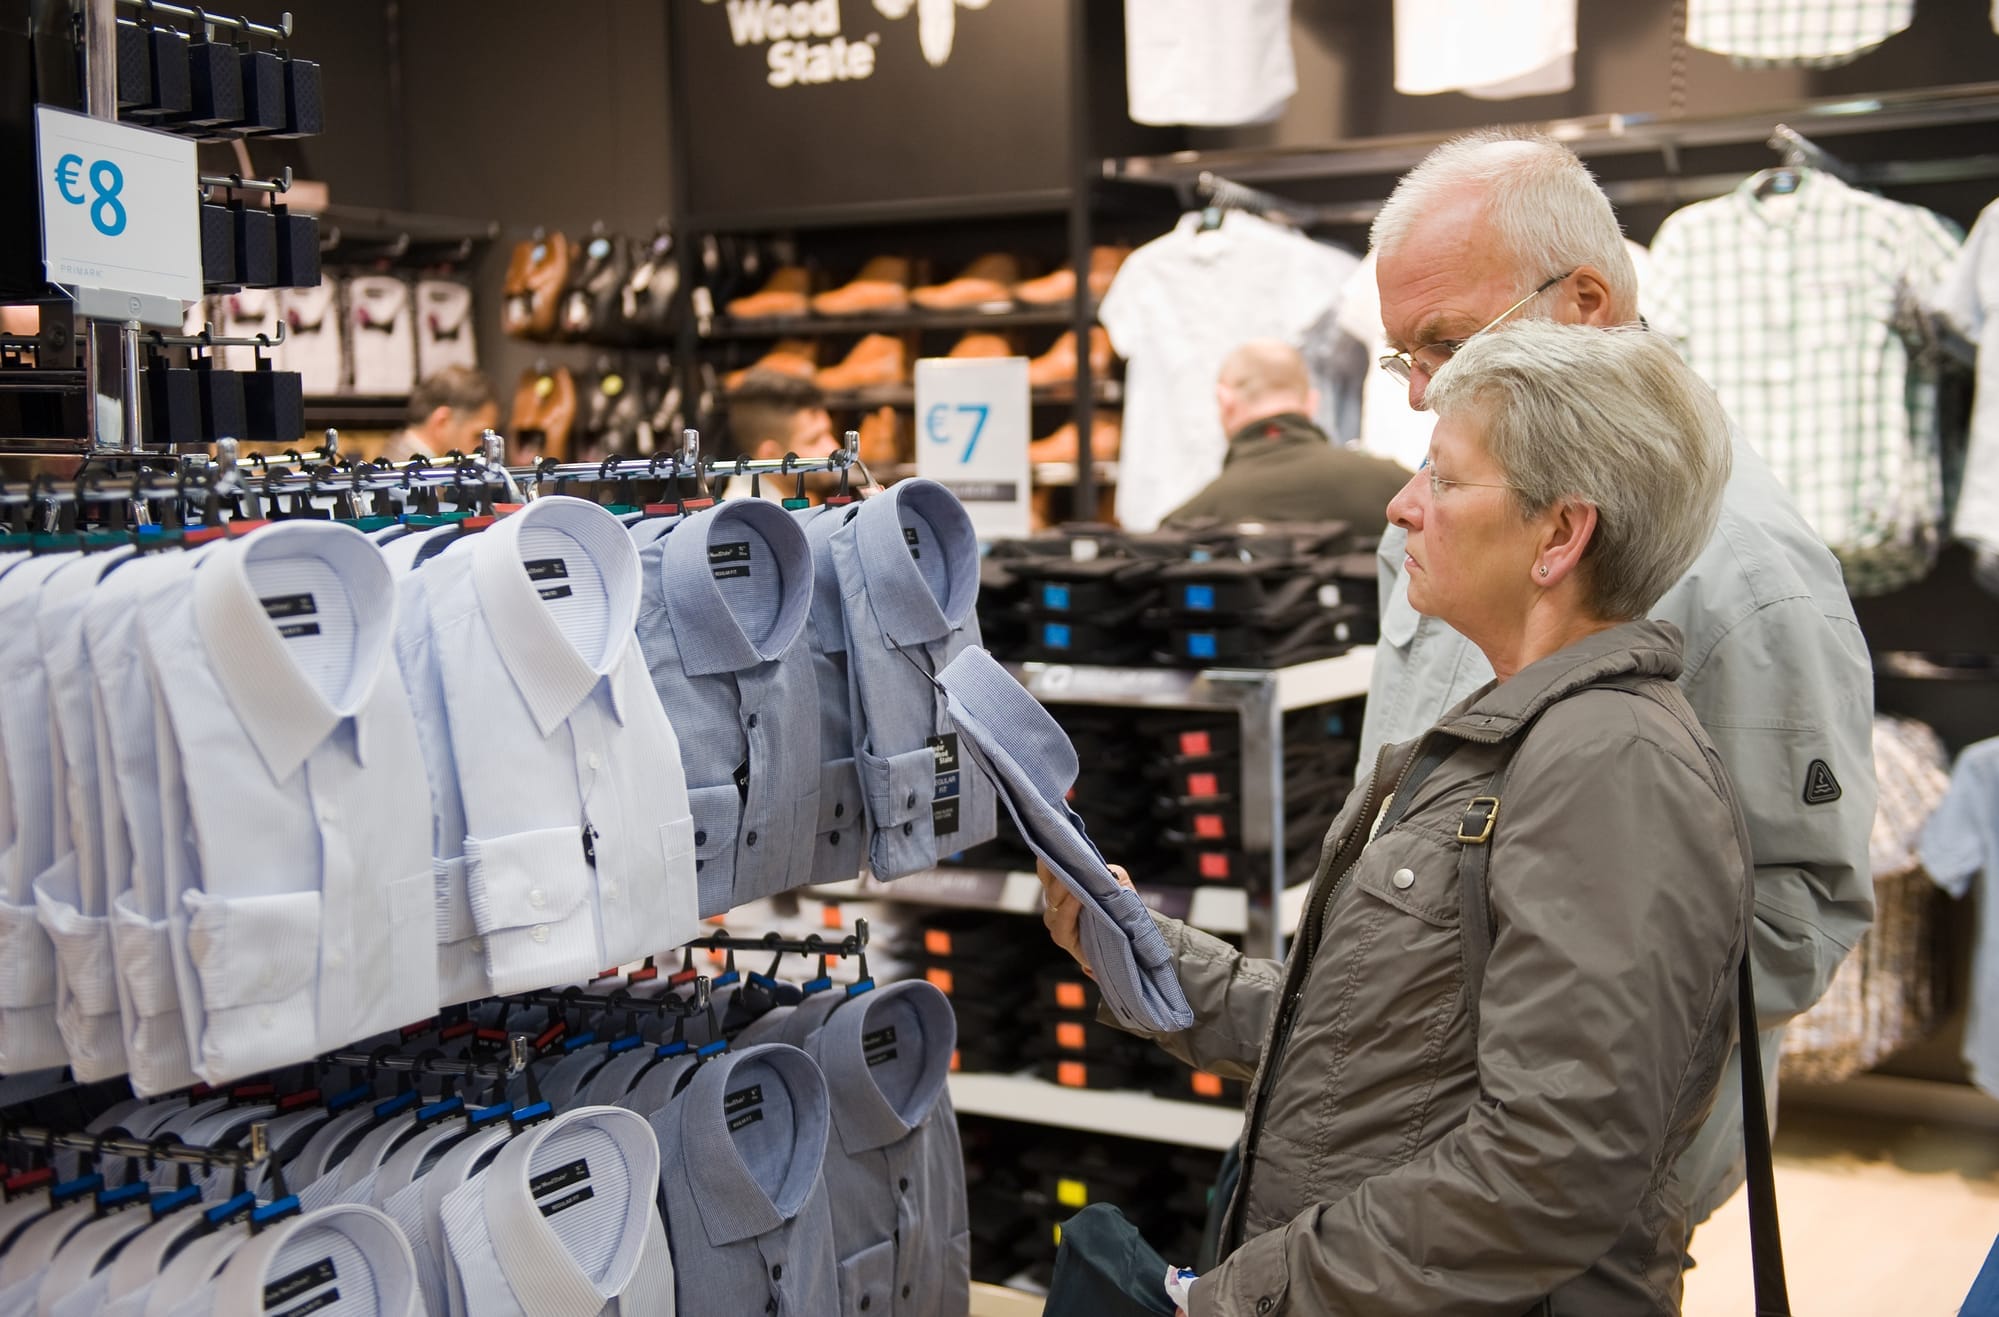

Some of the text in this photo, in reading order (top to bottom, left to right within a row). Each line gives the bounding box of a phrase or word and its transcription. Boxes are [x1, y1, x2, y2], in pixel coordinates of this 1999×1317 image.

[726, 0, 841, 46] Wood
[766, 36, 876, 87] State
[54, 153, 127, 237] €8
[926, 402, 990, 465] €7
